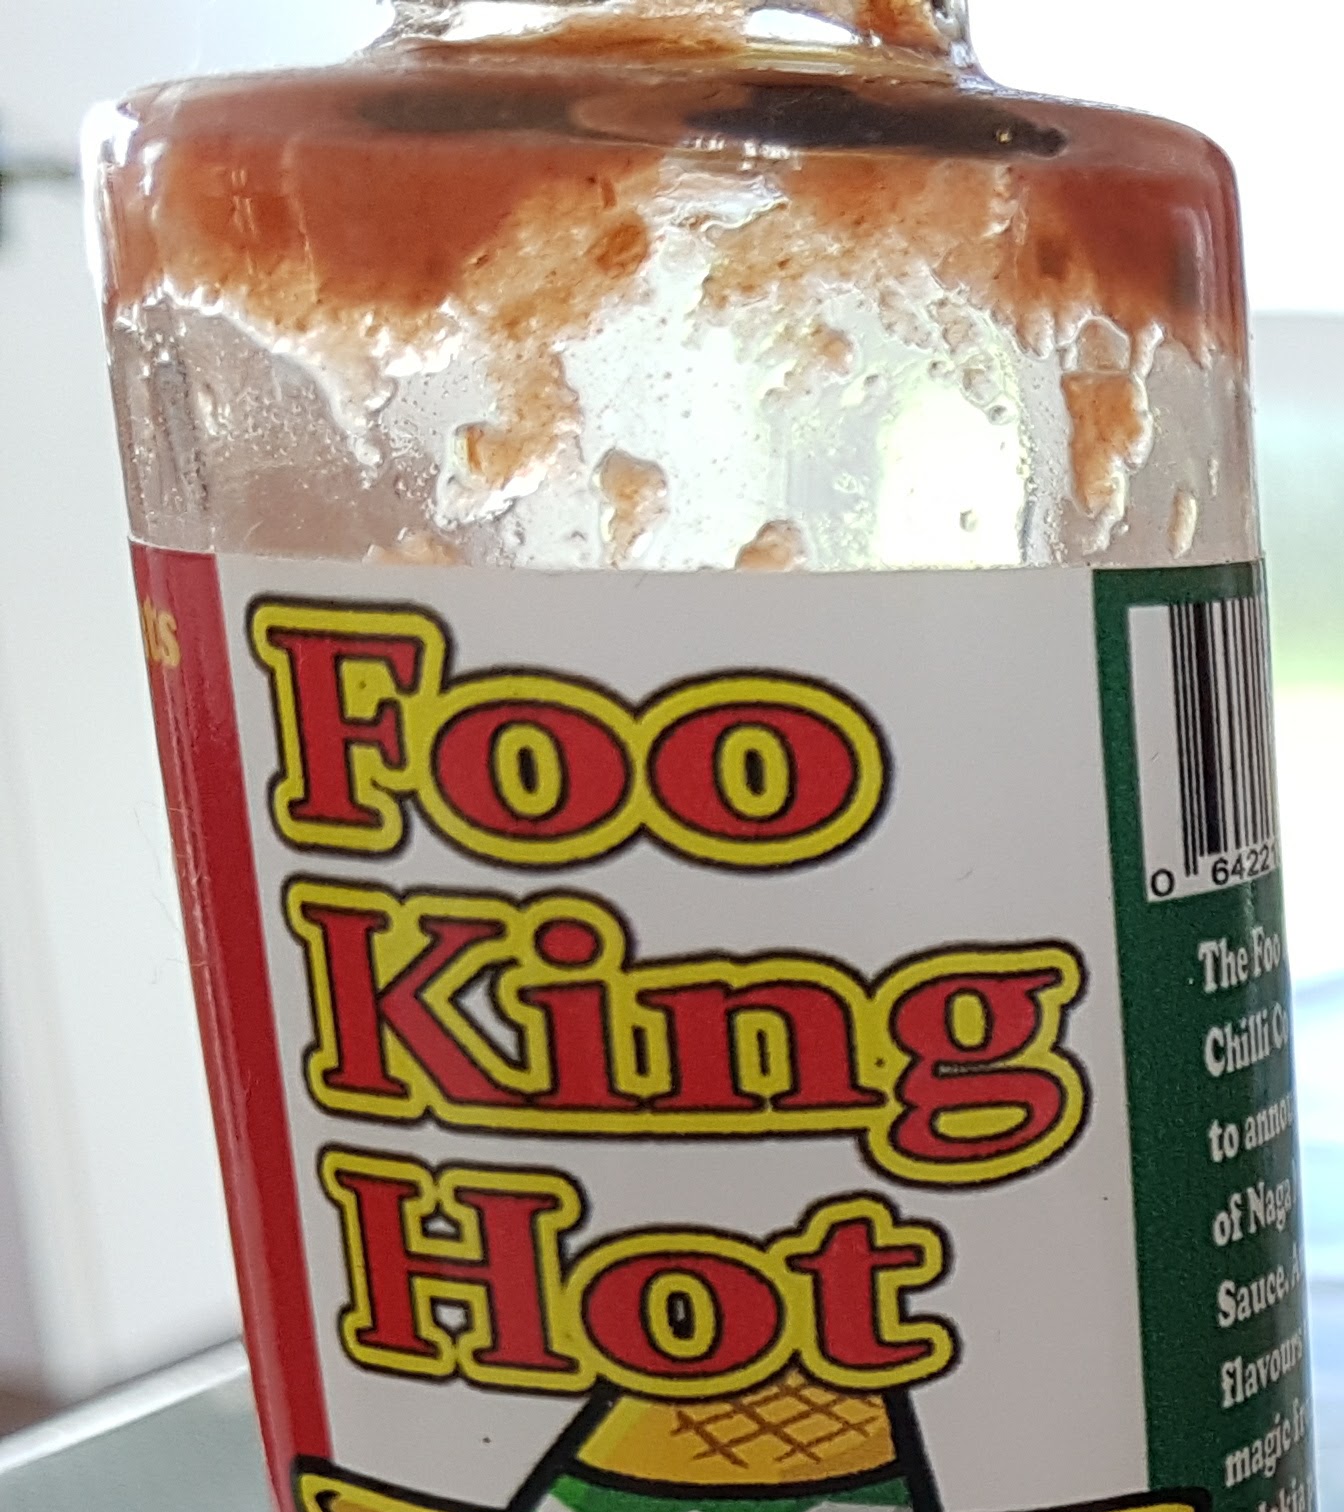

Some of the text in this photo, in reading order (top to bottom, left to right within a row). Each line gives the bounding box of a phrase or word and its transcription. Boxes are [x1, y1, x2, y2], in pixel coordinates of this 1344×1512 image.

[252, 597, 890, 868] Foo
[1198, 926, 1281, 994] The Foo
[284, 876, 1088, 1190] King
[1204, 1007, 1270, 1079] Chilli
[1208, 1118, 1240, 1164] to
[1213, 1191, 1244, 1247] of
[1246, 1177, 1292, 1233] Naga
[318, 1144, 959, 1398] Hot
[1224, 1412, 1291, 1488] magic
